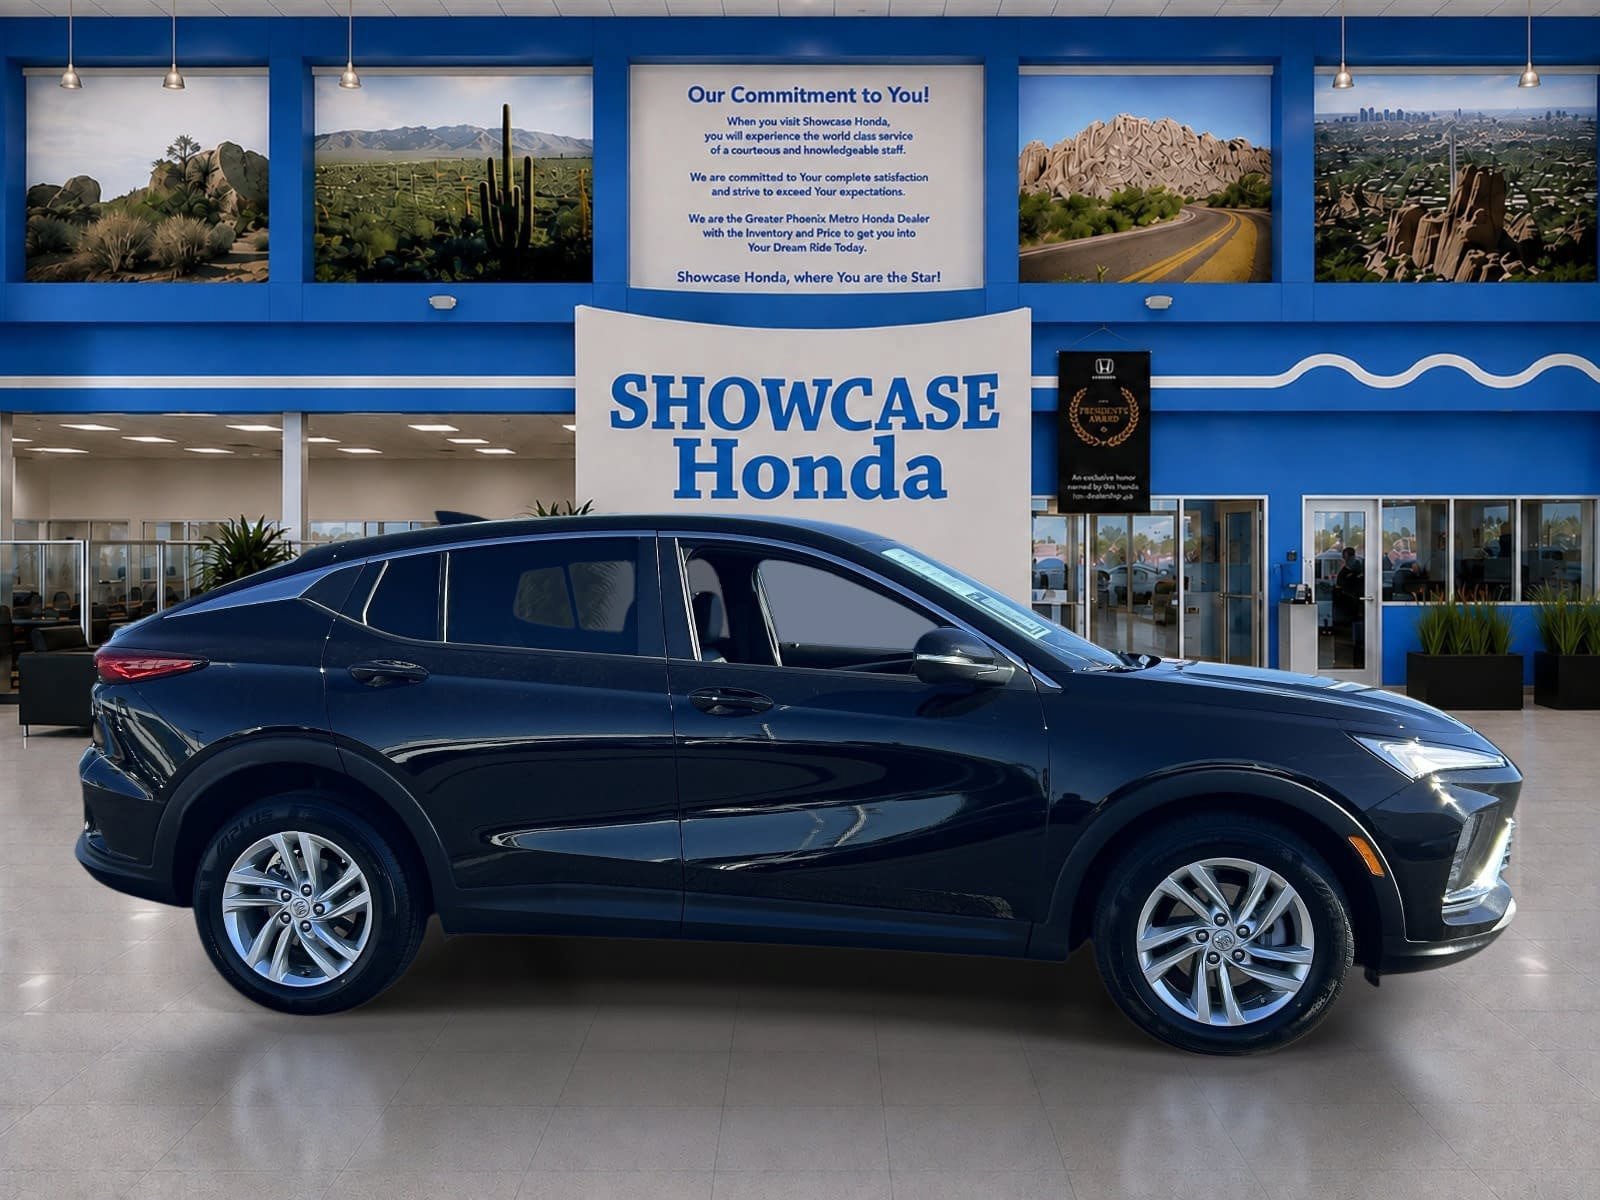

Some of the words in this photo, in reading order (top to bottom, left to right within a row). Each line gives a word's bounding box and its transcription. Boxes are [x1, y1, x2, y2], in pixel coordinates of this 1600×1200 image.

[688, 86, 725, 103] Our
[731, 86, 856, 103] Commitment
[862, 88, 882, 103] to
[887, 86, 928, 103] You!
[727, 116, 756, 126] When
[759, 119, 777, 128] you
[780, 117, 800, 126] visit
[803, 116, 852, 126] Showcase
[855, 117, 890, 128] Honda,
[705, 133, 723, 143] you
[725, 131, 743, 140] will
[745, 131, 800, 143] experience
[803, 131, 820, 140] the
[822, 131, 851, 141] world
[853, 131, 876, 141] class
[879, 131, 913, 141] service
[710, 145, 721, 154] of
[731, 147, 781, 155] courteous
[783, 145, 801, 154] and
[882, 145, 906, 154] staff.
[690, 172, 707, 182] We
[729, 172, 783, 182] committed
[786, 174, 797, 182] to
[800, 173, 822, 182] Your
[825, 173, 871, 184] complete
[874, 172, 928, 182] satisfaction
[712, 186, 730, 196] and
[732, 187, 760, 196] strive
[763, 188, 774, 196] to
[776, 187, 812, 196] exceed
[814, 187, 837, 196] Your
[839, 187, 905, 199] expectations.
[689, 214, 705, 223] We
[726, 213, 742, 223] the
[745, 214, 784, 223] Greater
[786, 214, 826, 223] Phoenix
[829, 214, 859, 223] Metro
[862, 214, 894, 223] Honda
[898, 214, 930, 223] Dealer
[703, 228, 724, 237] with
[727, 228, 743, 237] the
[746, 228, 793, 240] Inventory
[795, 228, 814, 238] and
[817, 228, 841, 238] Price
[844, 230, 854, 238] to
[857, 230, 874, 240] get
[876, 231, 894, 240] you
[897, 228, 916, 237] into
[748, 243, 771, 252] Your
[773, 243, 807, 252] Dream
[810, 242, 832, 252] Ride
[834, 243, 867, 254] Today.
[677, 271, 740, 283] Showcase
[745, 271, 789, 285] Honda,
[794, 271, 833, 283] where
[837, 272, 860, 283] You
[864, 275, 883, 283] are
[887, 271, 907, 283] the
[911, 271, 940, 283] Star!
[609, 373, 1000, 432] SHOWCASE
[672, 434, 949, 500] Honda
